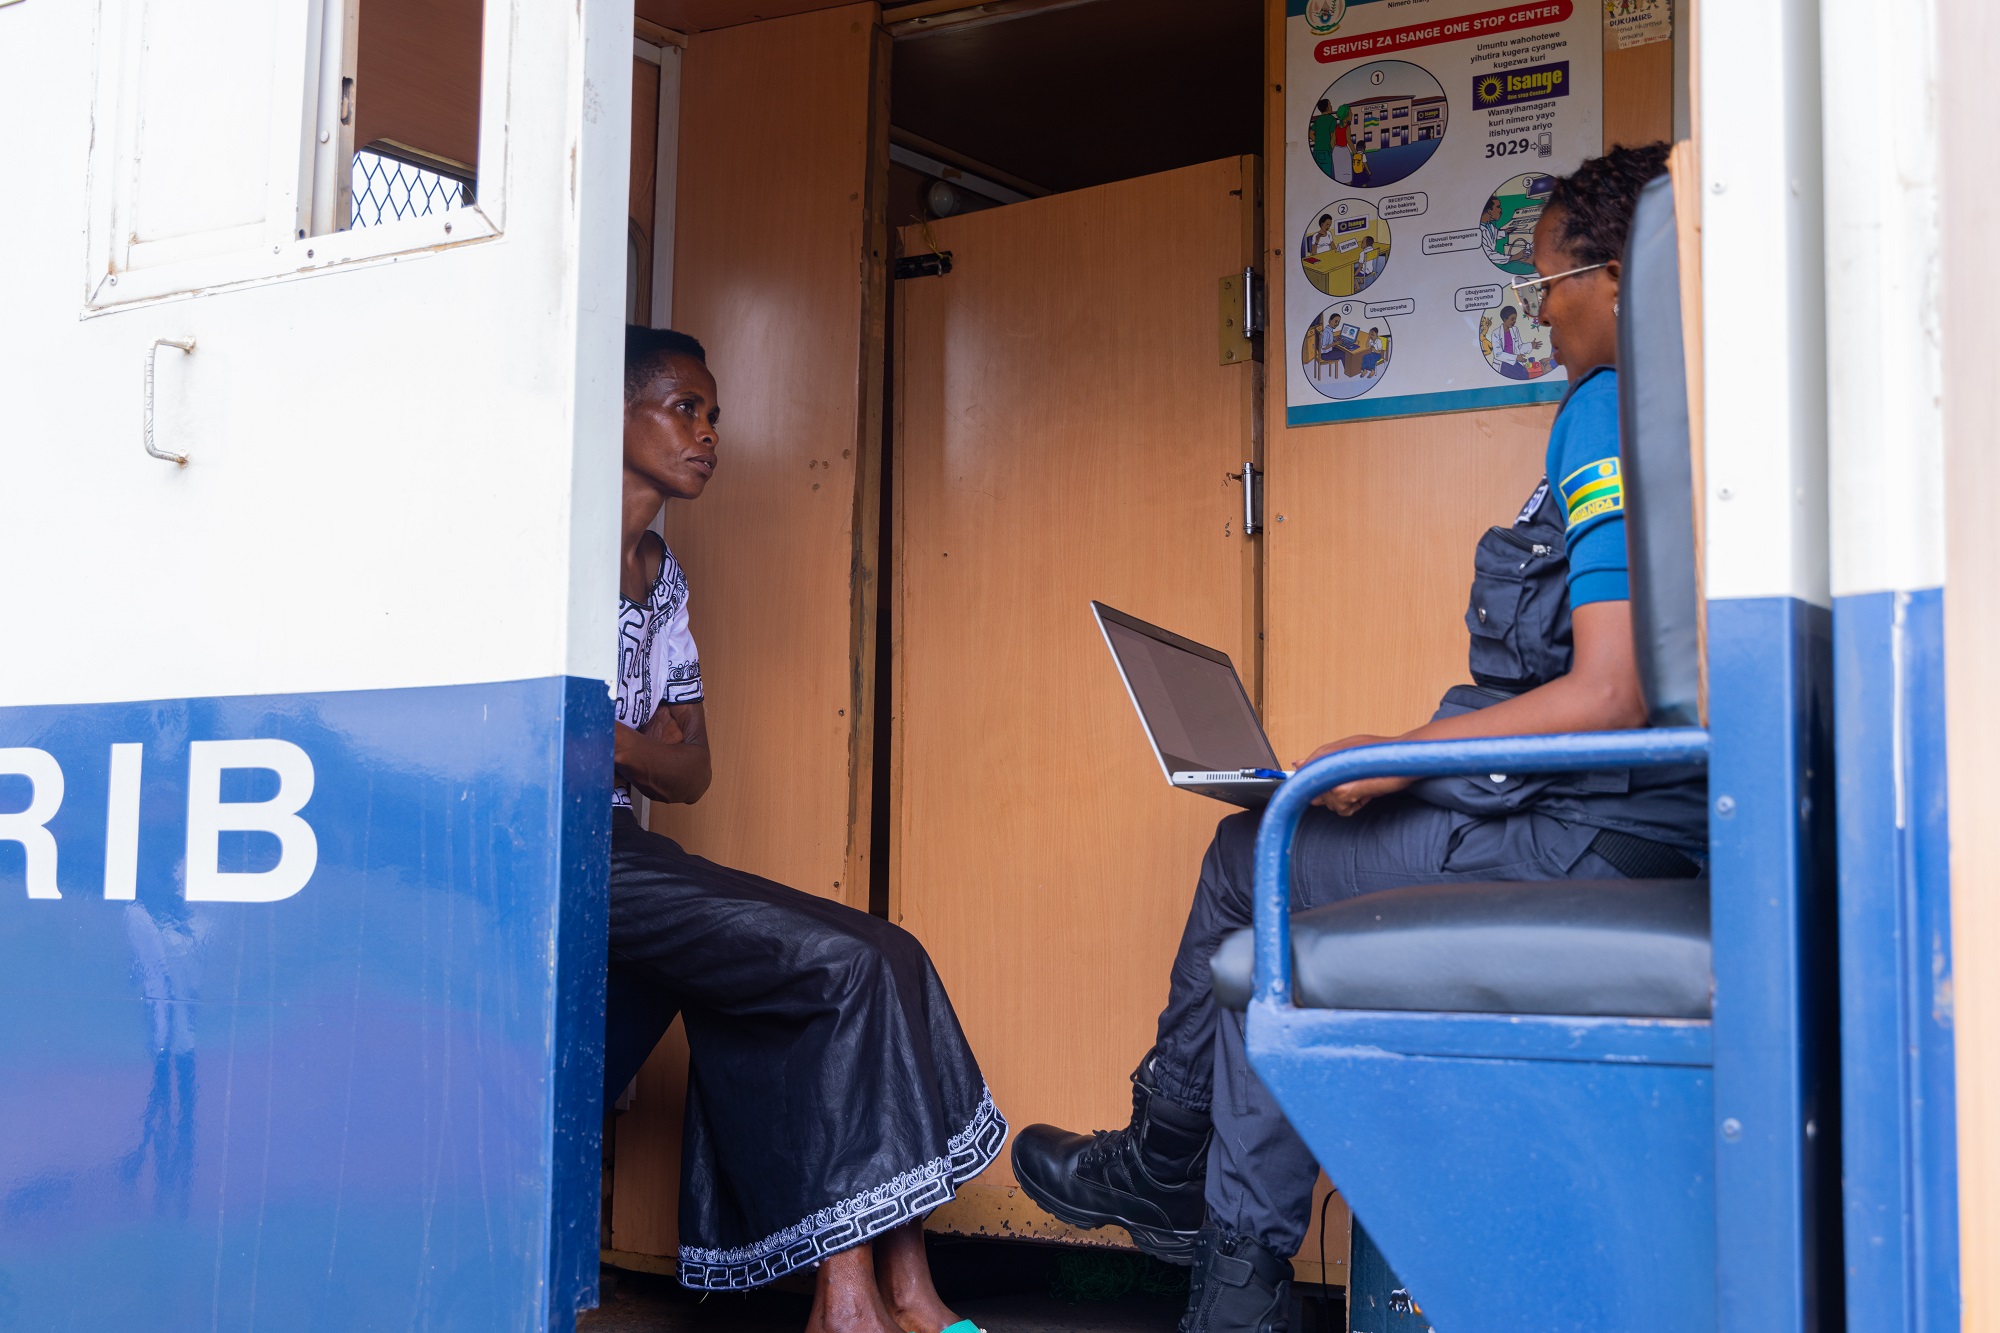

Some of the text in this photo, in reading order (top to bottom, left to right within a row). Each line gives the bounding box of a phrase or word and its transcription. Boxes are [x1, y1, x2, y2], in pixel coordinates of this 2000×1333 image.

[1323, 5, 1560, 56] SERIVISI ZA ISANGE ONE STOP CENTER
[1477, 31, 1560, 51] Umuntu wahohotewe
[1470, 40, 1567, 64] yihutira kugera cyangwa
[1493, 53, 1546, 69] kugezwa kuri
[1507, 69, 1563, 94] Isange
[1487, 101, 1556, 117] Wanayihamagara
[1488, 111, 1555, 127] kuri nimero yayo
[1489, 122, 1553, 137] itishyurwa ariyo
[1485, 138, 1529, 158] 3029
[1570, 498, 1615, 524] WANDA
